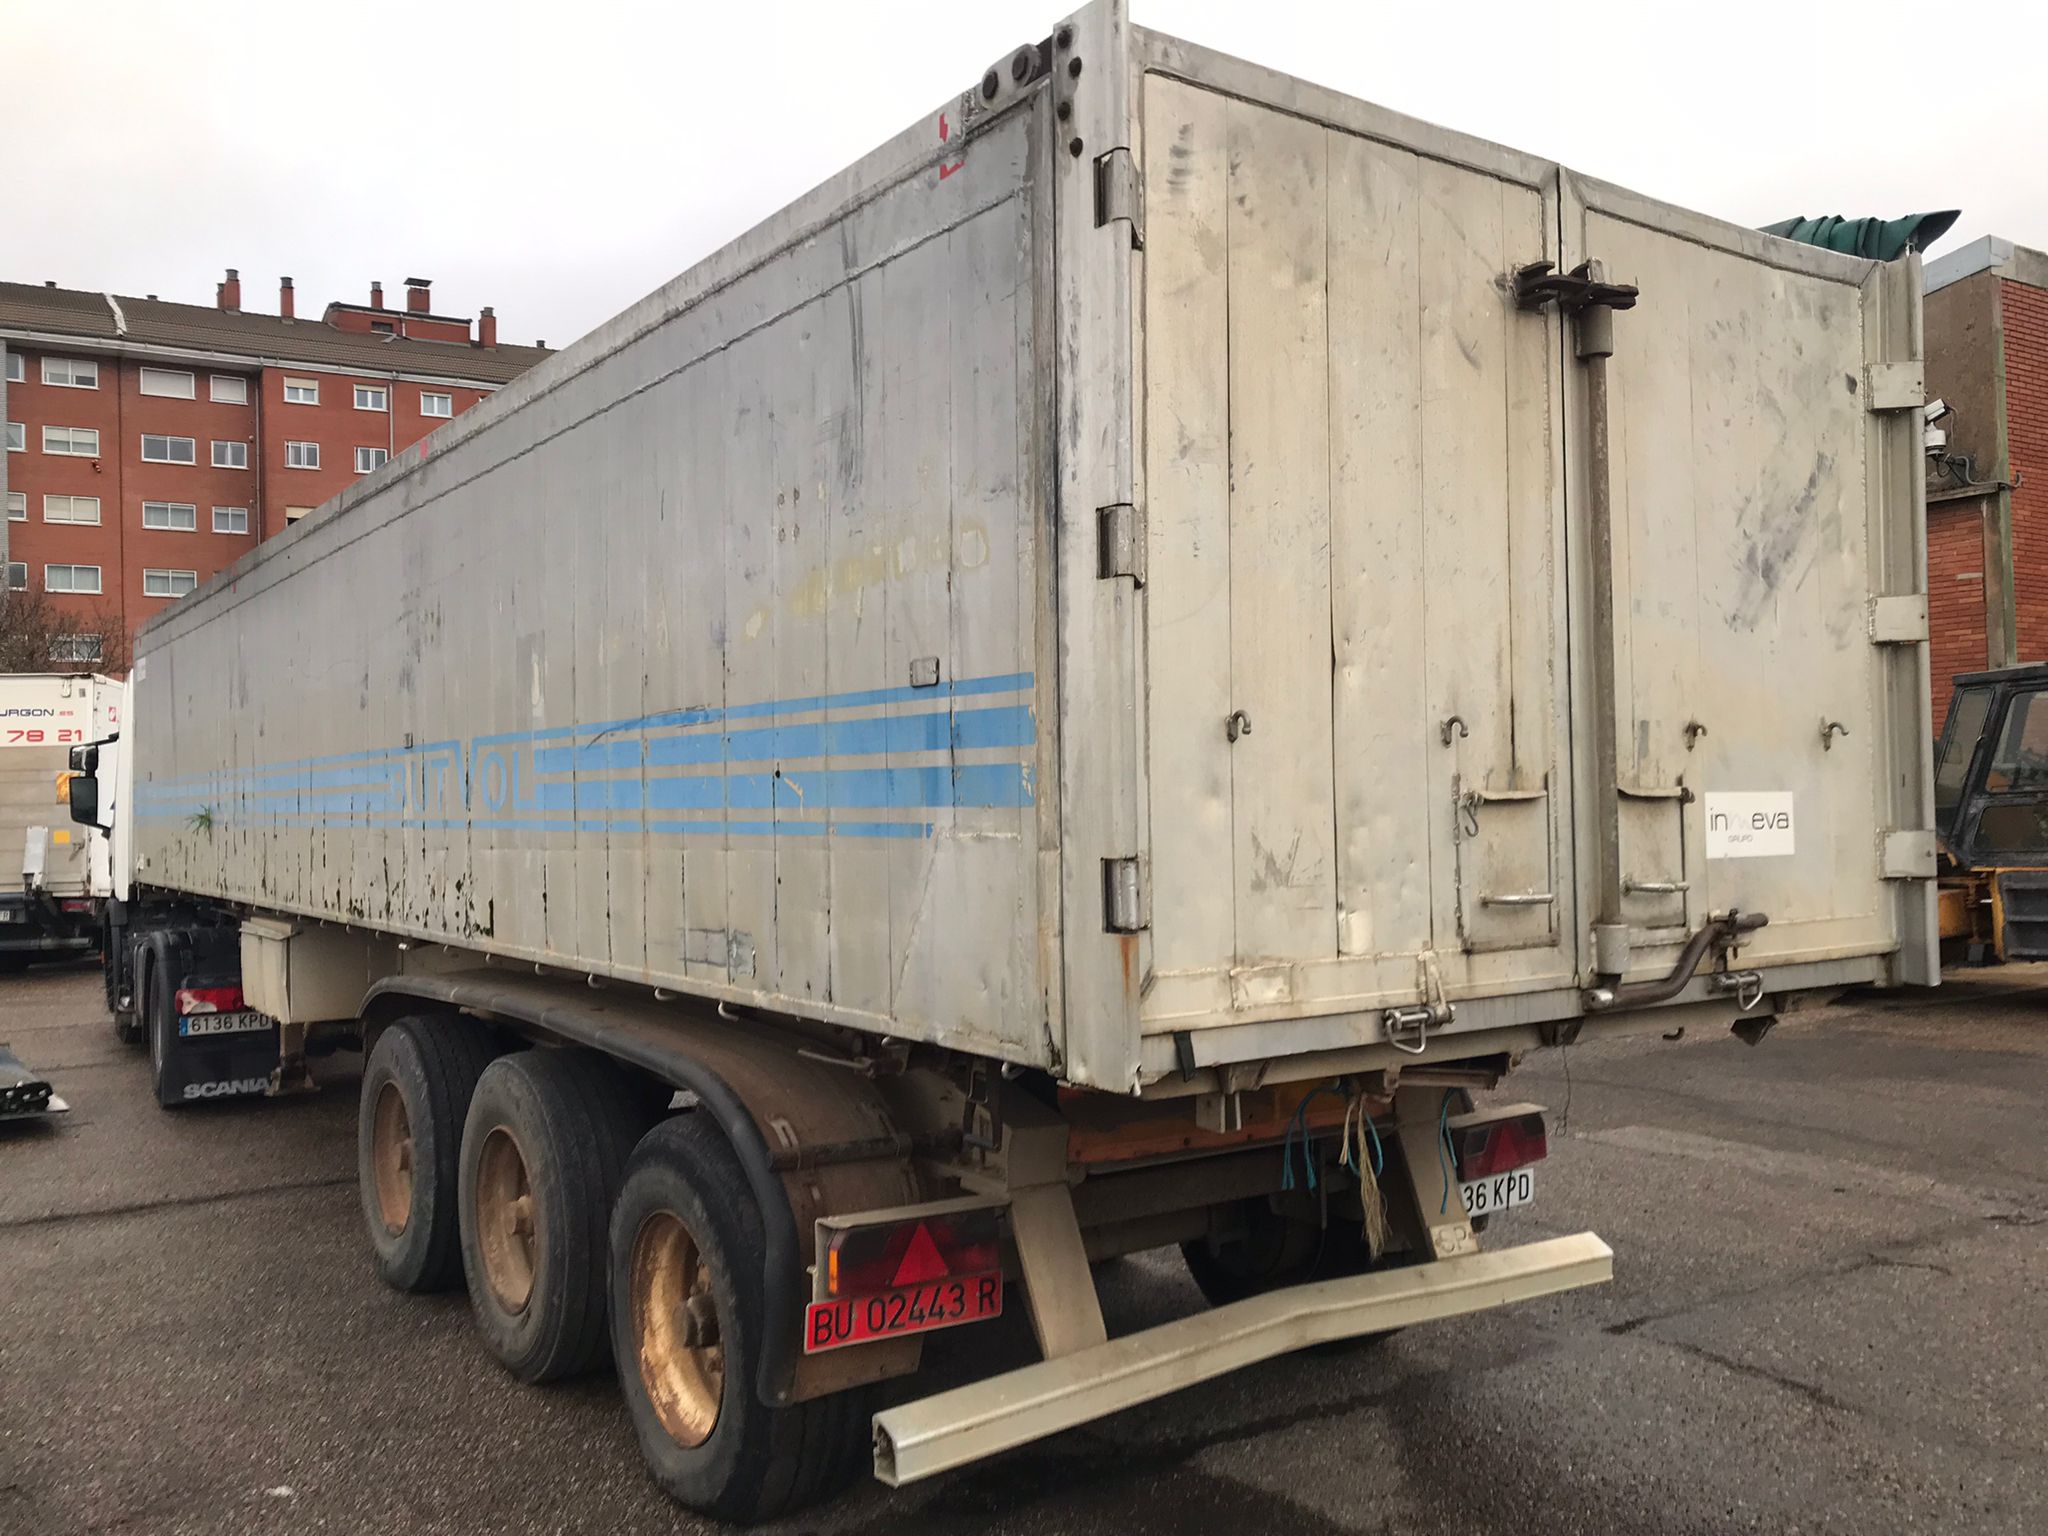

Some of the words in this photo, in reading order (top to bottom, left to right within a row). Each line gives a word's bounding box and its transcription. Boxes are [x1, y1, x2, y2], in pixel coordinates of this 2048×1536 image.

[7, 729, 45, 743] 78
[58, 729, 82, 742] 21
[191, 1016, 233, 1033] 6136
[238, 1014, 269, 1029] KPD
[183, 1077, 271, 1099] SCANIA
[1493, 1174, 1529, 1207] KPD
[813, 1303, 854, 1346] BU
[867, 1283, 966, 1333] 02443
[978, 1278, 996, 1313] R
